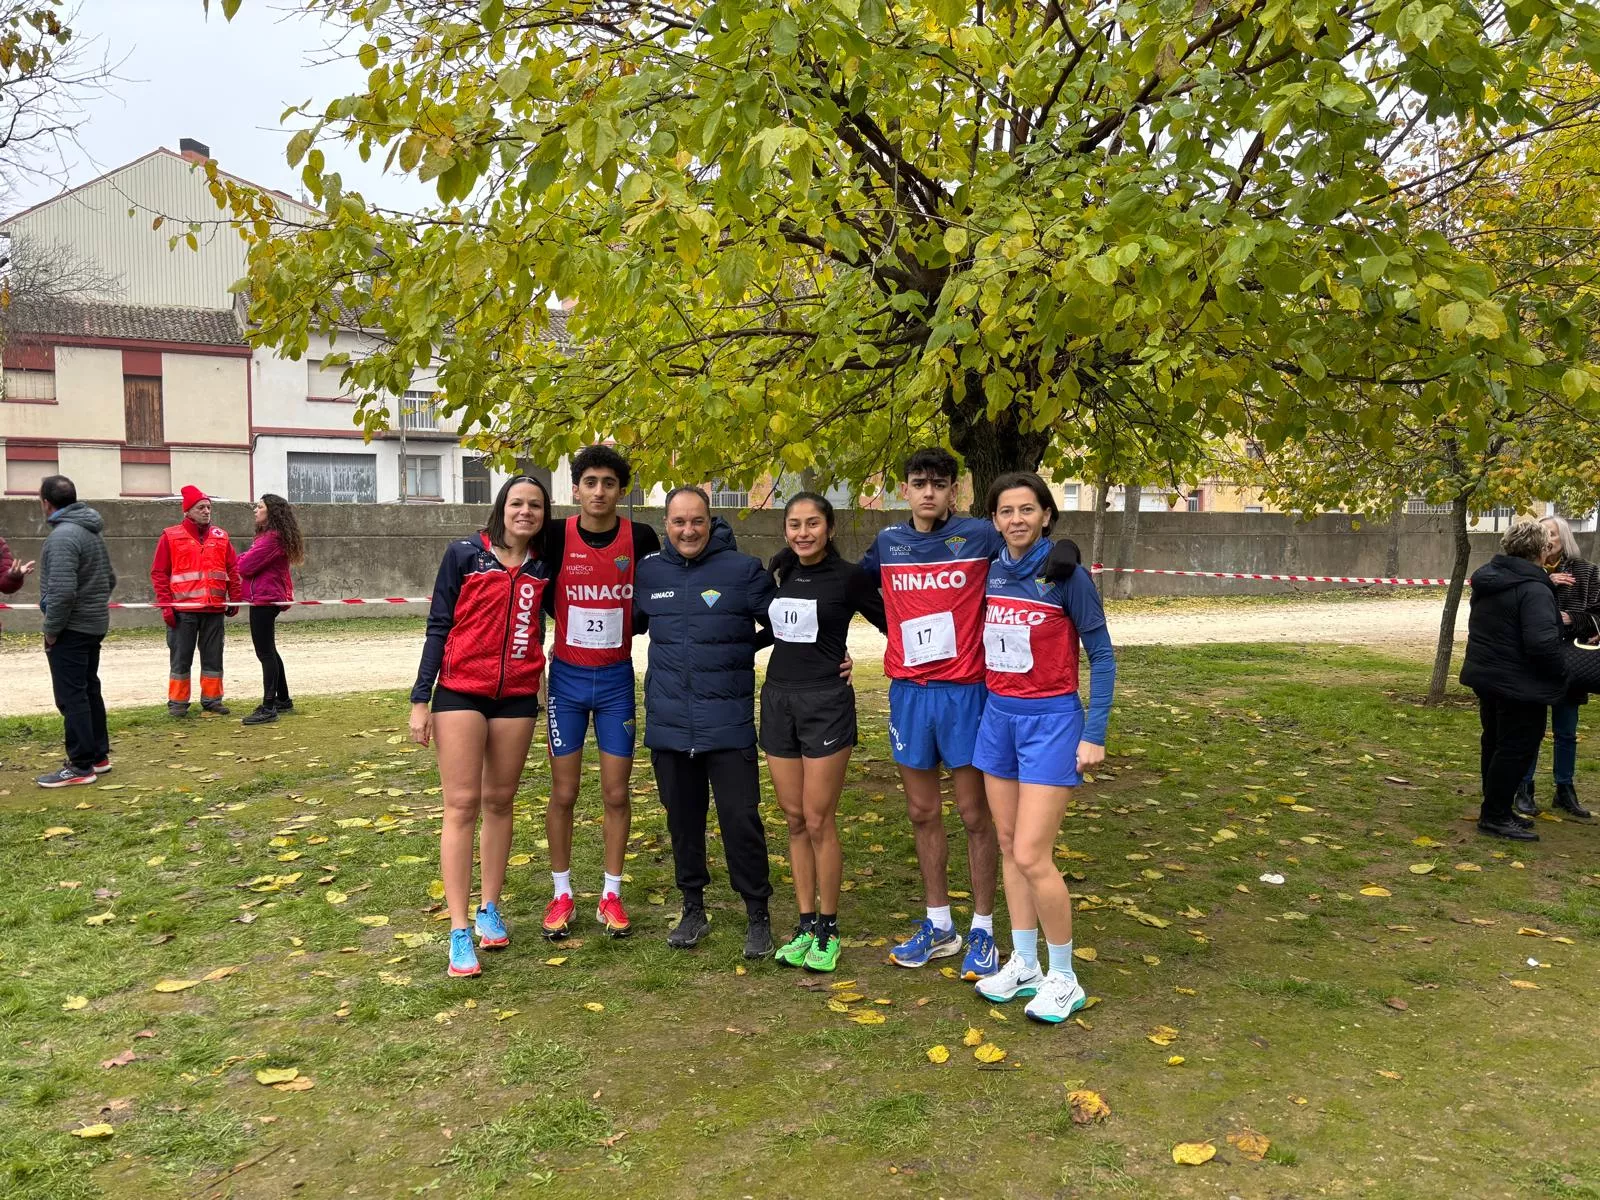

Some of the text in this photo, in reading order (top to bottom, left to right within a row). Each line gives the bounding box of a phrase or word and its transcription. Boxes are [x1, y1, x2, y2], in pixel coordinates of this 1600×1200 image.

[891, 570, 967, 591] HINACO
[565, 583, 634, 601] HINACO
[650, 591, 675, 600] HINACO
[511, 583, 535, 659] HINACO
[586, 619, 603, 632] 23
[784, 610, 798, 625] 10
[916, 627, 932, 646] 17
[999, 638, 1006, 653] 1
[548, 696, 562, 747] hinaco
